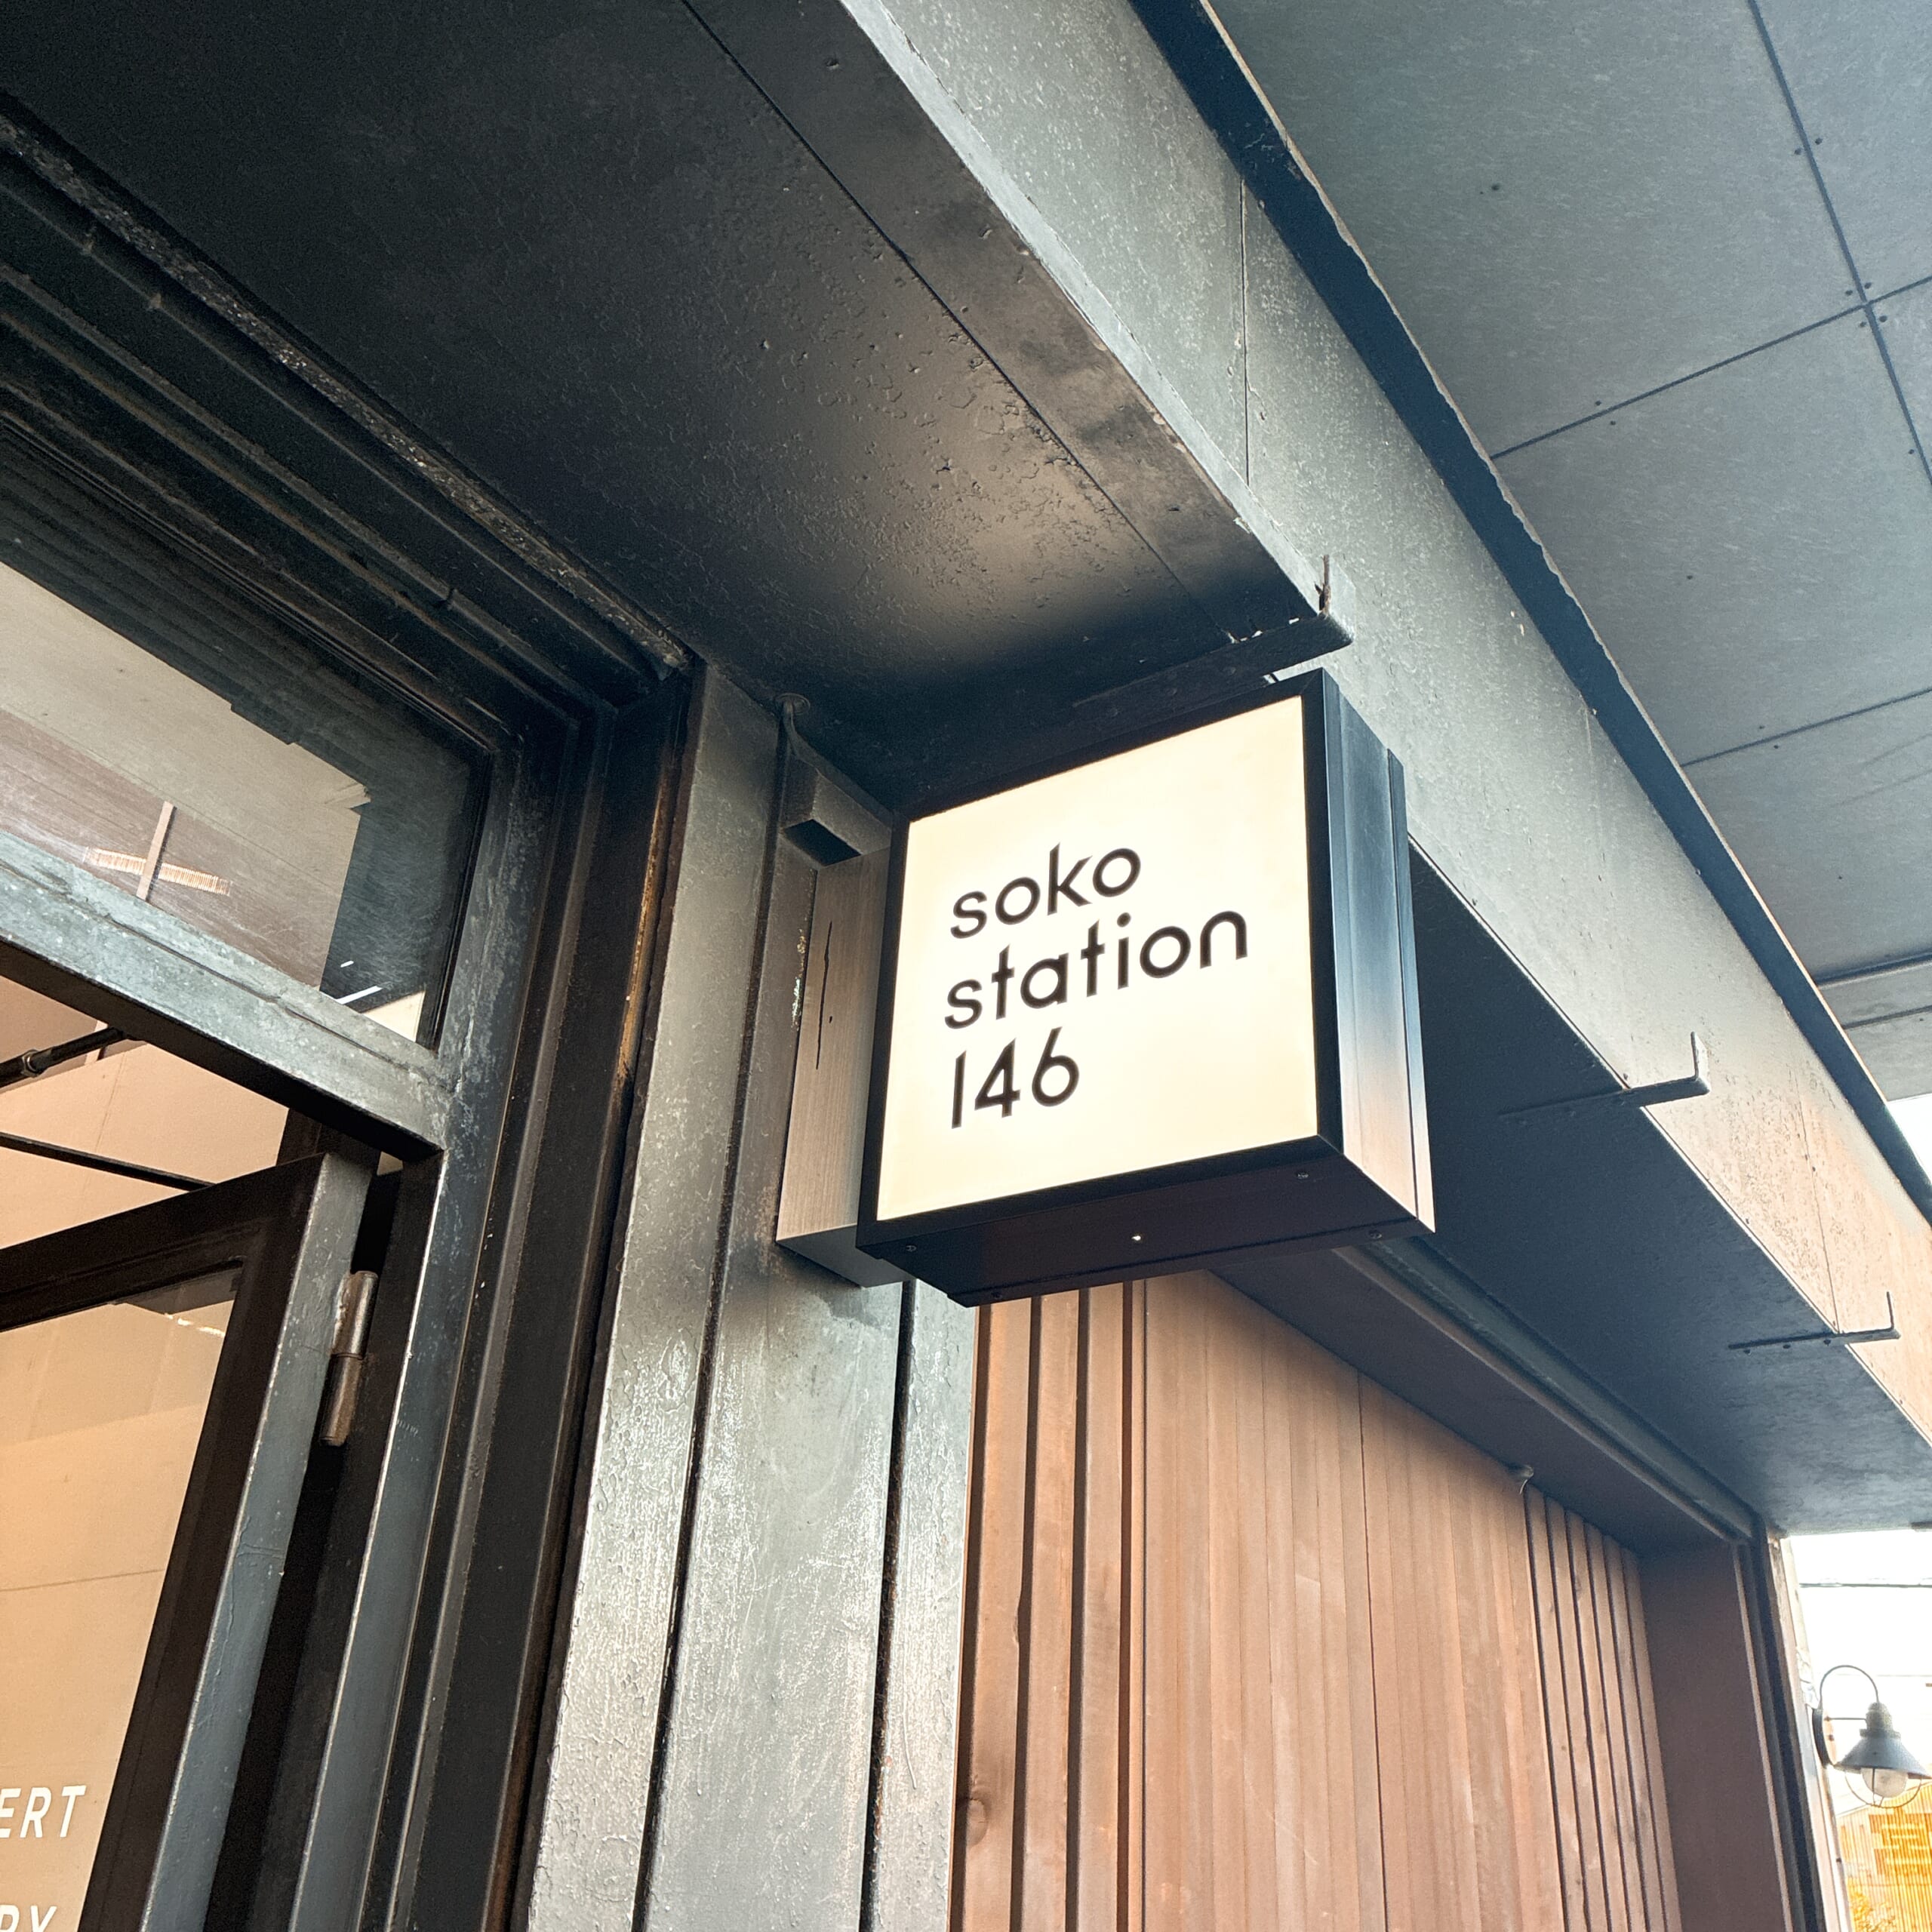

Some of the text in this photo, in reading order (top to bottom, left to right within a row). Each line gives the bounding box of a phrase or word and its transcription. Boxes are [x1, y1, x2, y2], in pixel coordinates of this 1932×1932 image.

[949, 842, 1142, 940] soko
[943, 911, 1249, 1031] station
[950, 1026, 1081, 1131] 146
